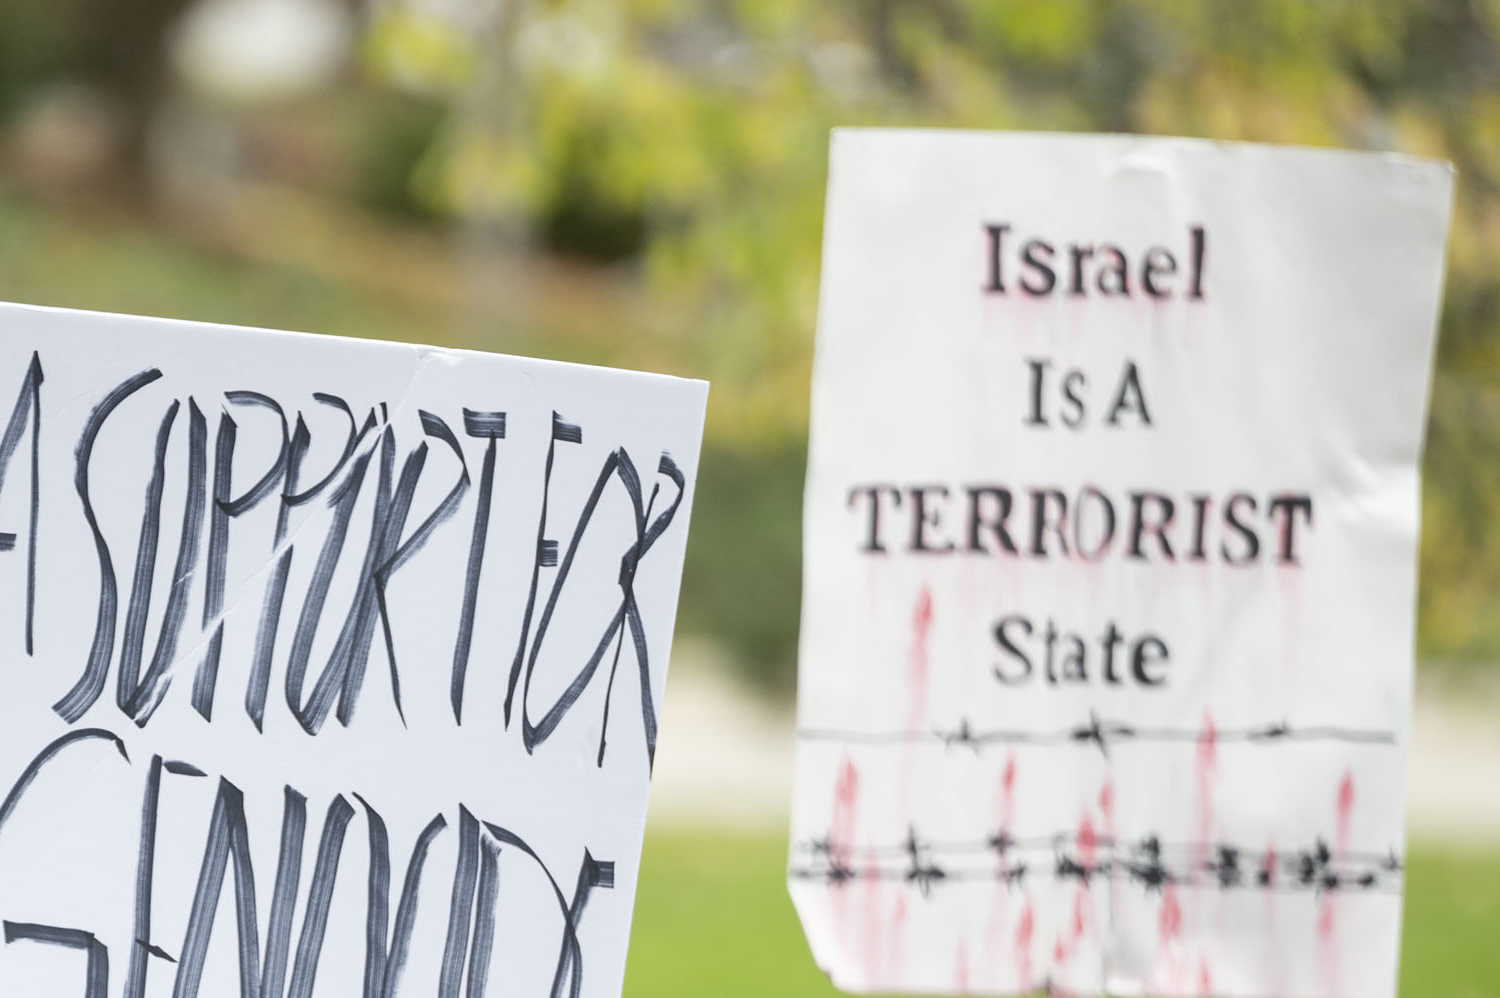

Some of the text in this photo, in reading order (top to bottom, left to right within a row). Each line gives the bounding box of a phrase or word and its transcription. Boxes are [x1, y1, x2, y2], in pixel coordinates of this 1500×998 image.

[981, 222, 1209, 301] Israel
[1022, 358, 1155, 430] Is A
[847, 483, 1316, 569] TERRORIST
[51, 366, 507, 736] SUPPORT
[503, 408, 686, 780] FOR
[990, 613, 1172, 689] State
